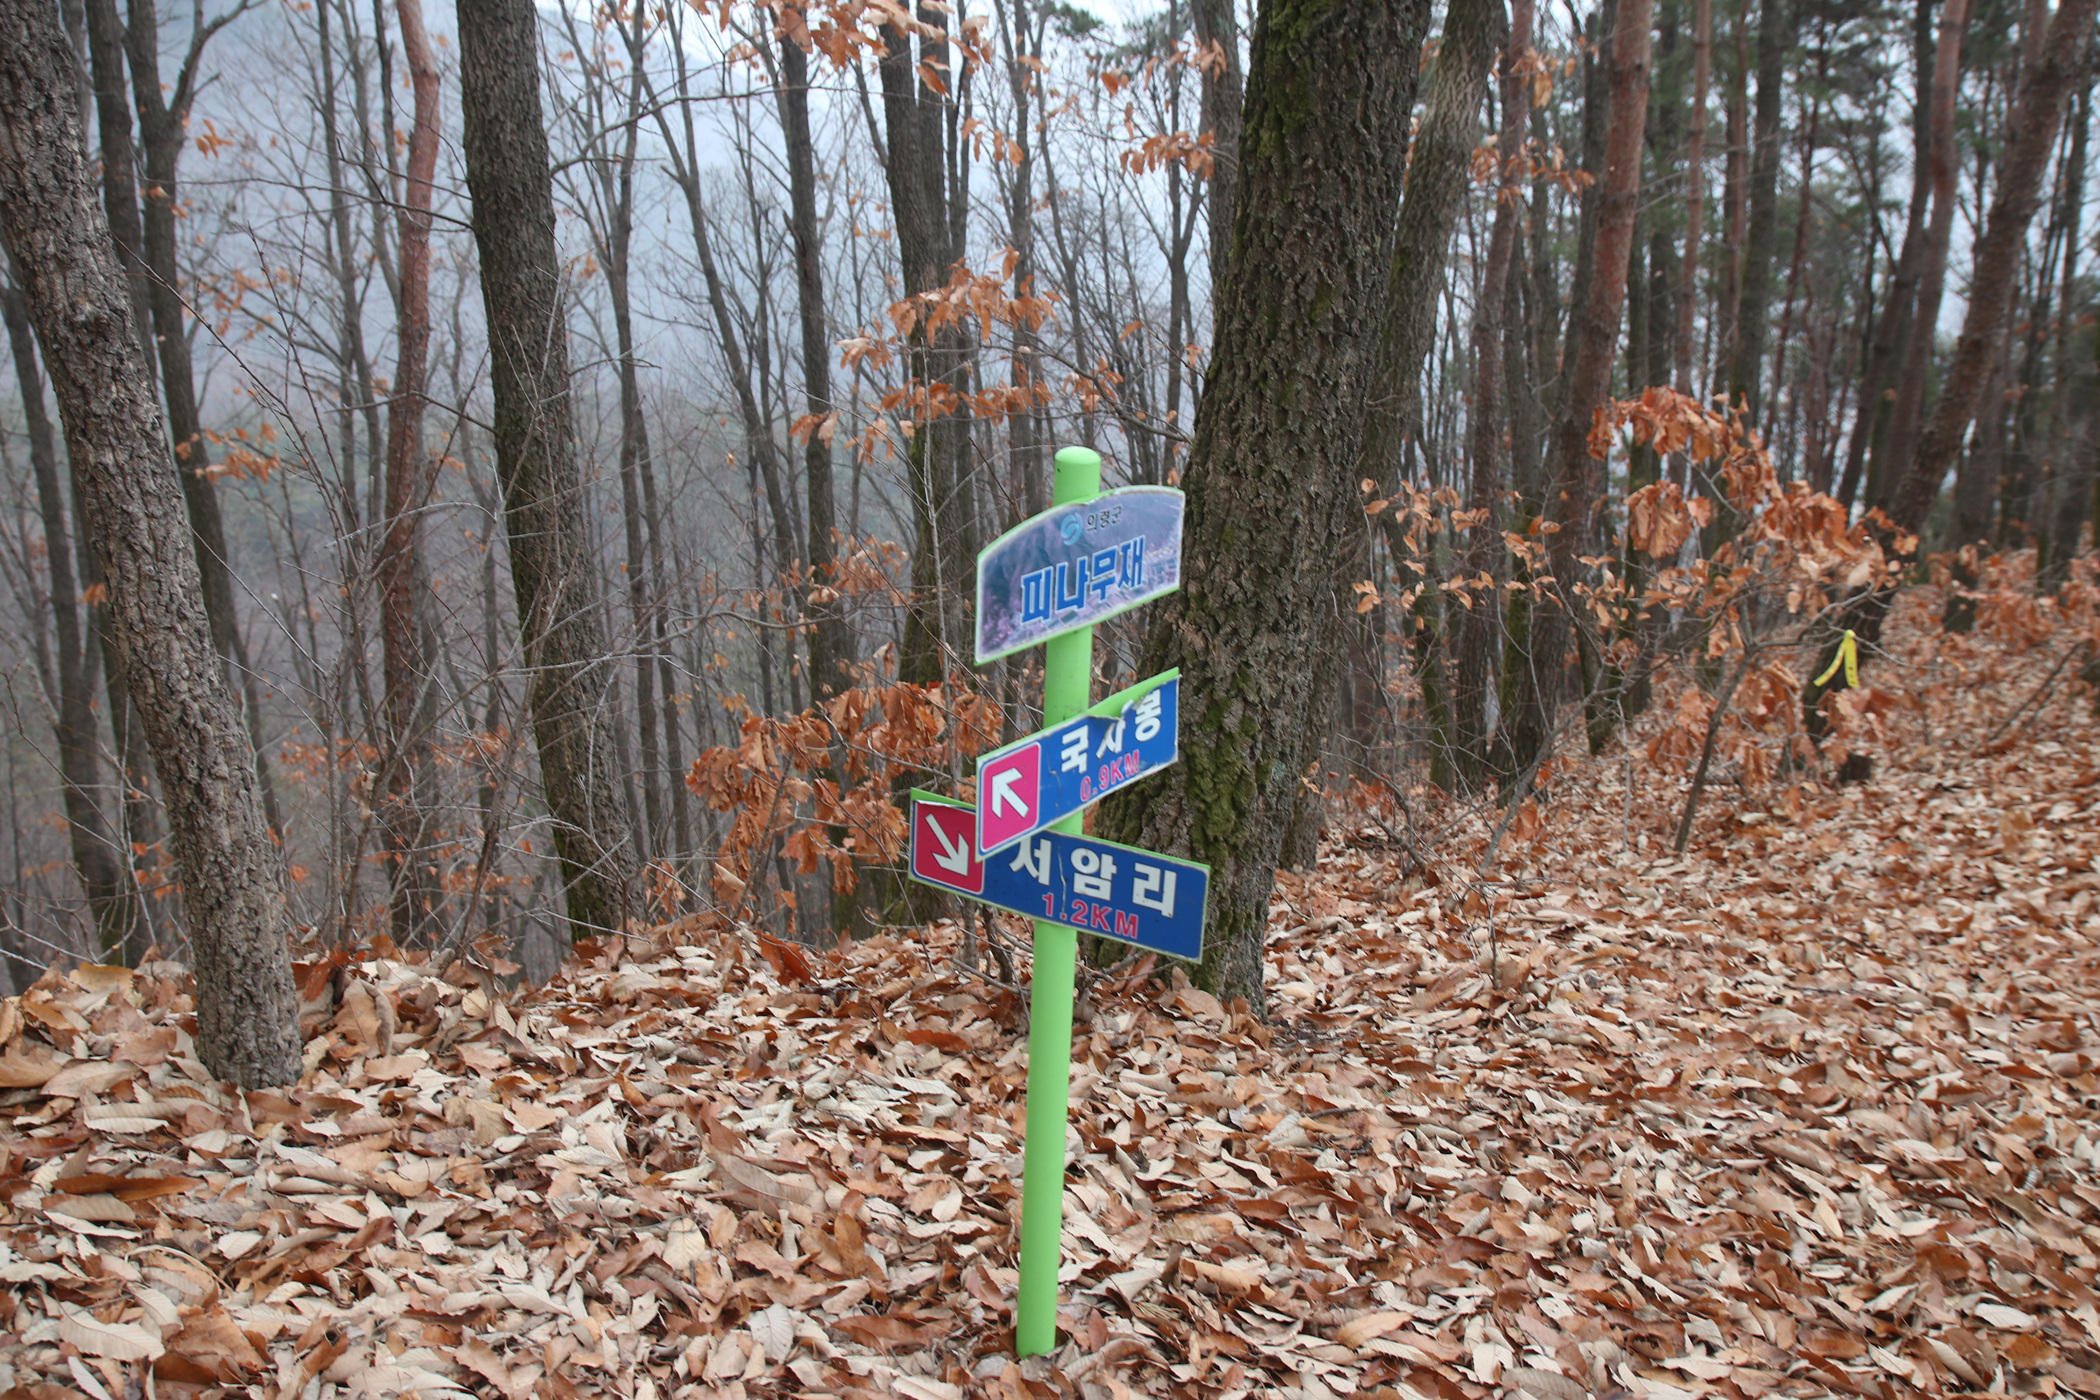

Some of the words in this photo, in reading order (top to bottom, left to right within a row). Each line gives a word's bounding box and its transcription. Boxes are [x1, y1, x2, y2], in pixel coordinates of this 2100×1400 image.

[1086, 504, 1122, 532] 의령군
[1021, 535, 1145, 625] 피나무재
[1061, 688, 1161, 775] 국사봉
[1080, 749, 1140, 802] 0.9KM
[1009, 836, 1177, 918] 서암리
[1042, 893, 1139, 939] 1.2KM
